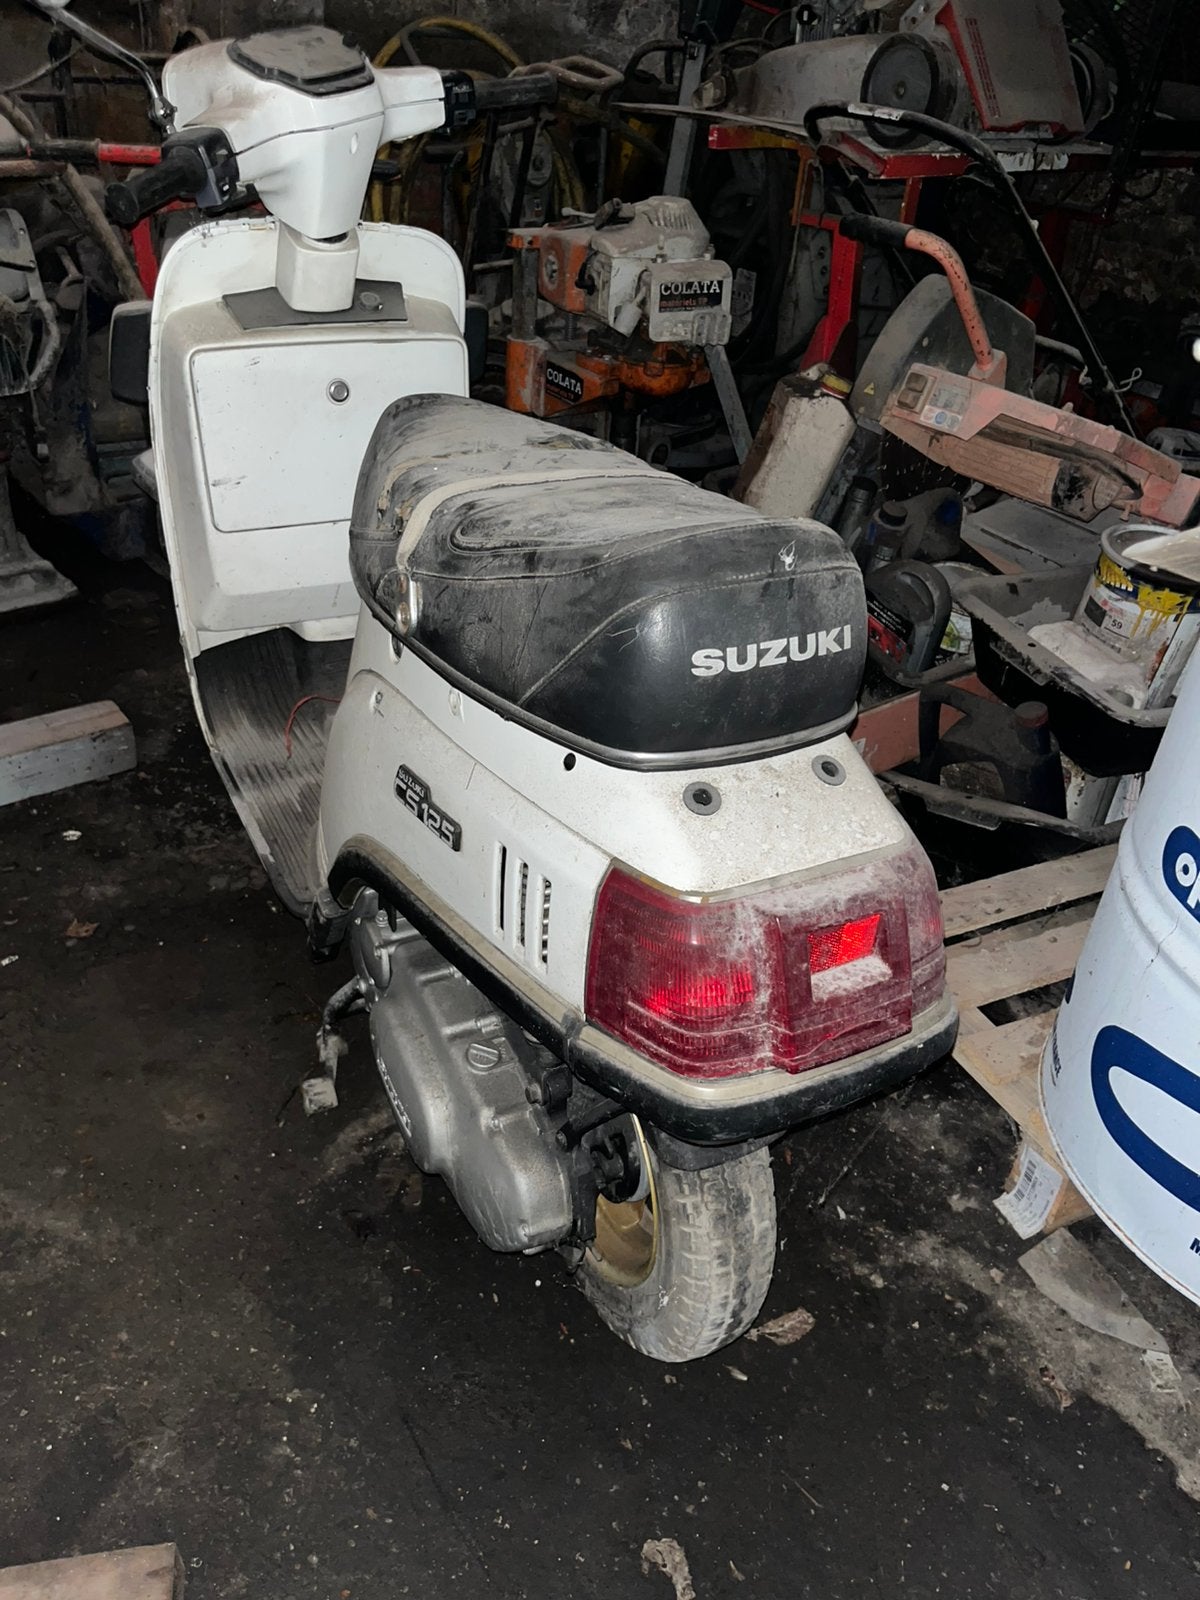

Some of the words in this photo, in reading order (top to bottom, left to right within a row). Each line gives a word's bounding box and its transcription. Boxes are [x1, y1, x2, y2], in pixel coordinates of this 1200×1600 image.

[661, 280, 720, 295] COLATA
[546, 368, 582, 395] COLATA
[1111, 619, 1123, 630] 59
[690, 624, 852, 677] SUZUKI
[398, 769, 425, 798] SUZUKI
